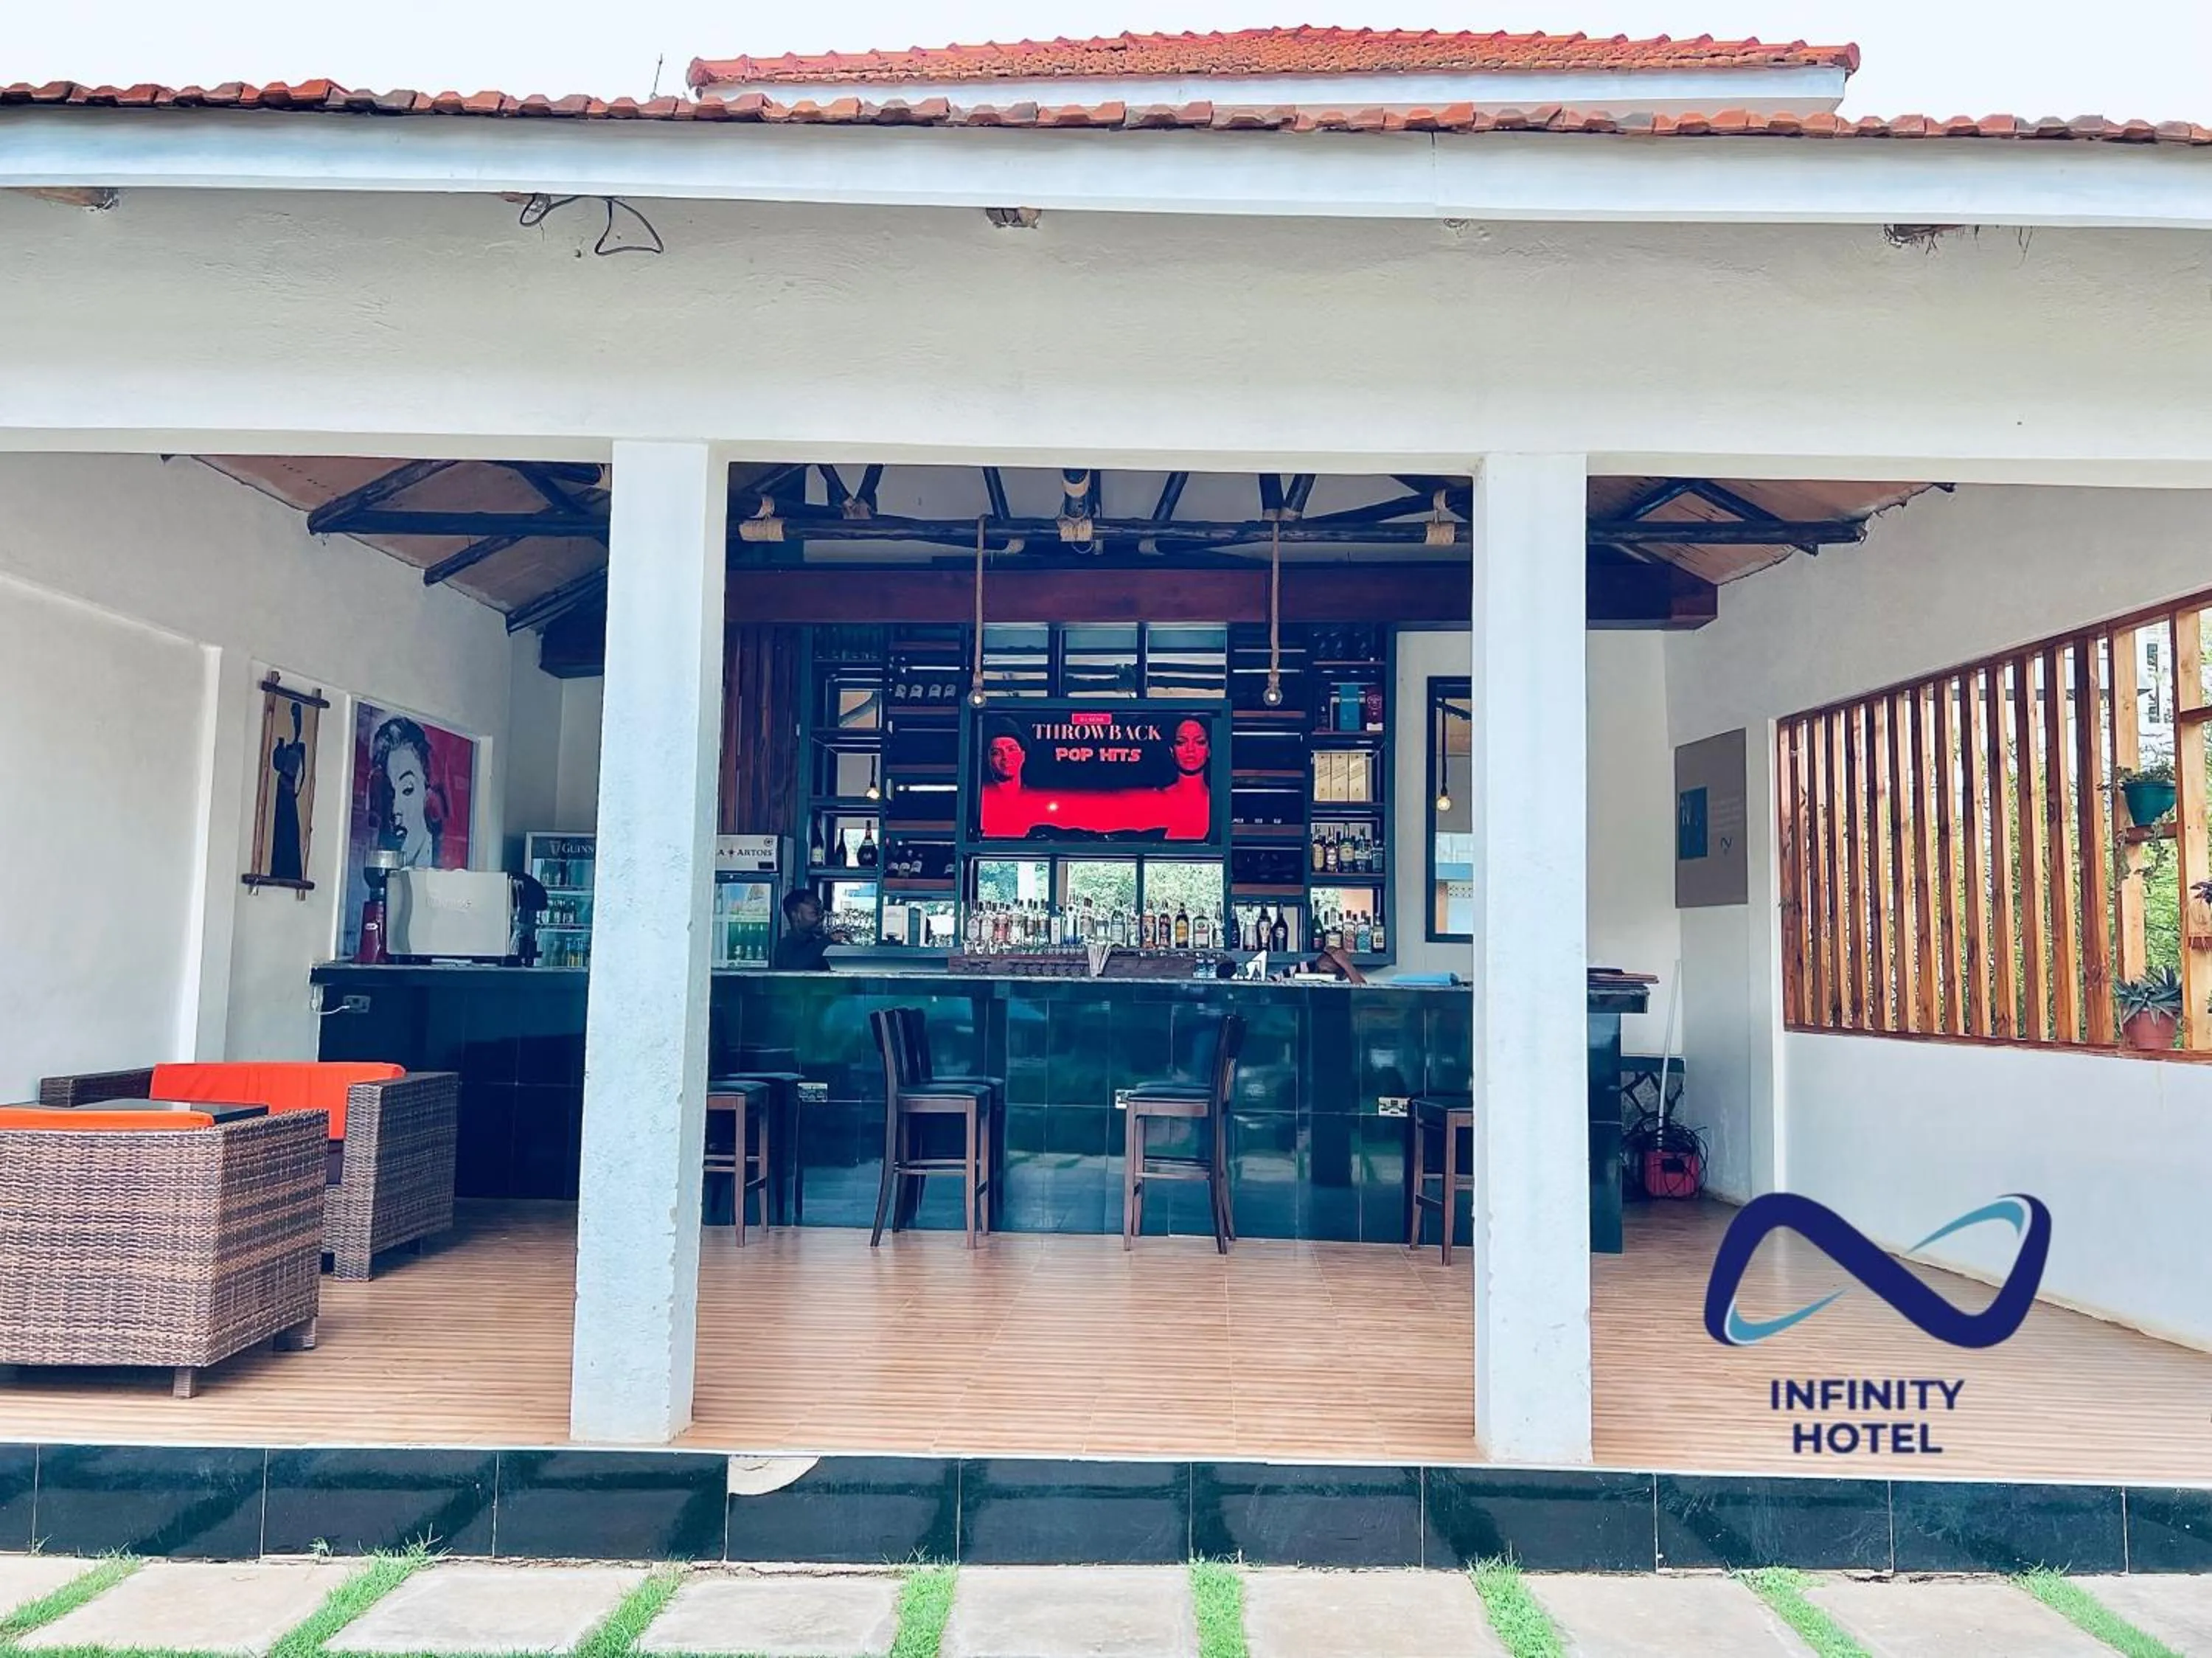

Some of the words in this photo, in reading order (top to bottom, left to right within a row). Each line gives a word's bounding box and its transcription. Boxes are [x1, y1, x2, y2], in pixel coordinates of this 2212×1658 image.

[1032, 724, 1162, 740] THROWBACK
[1055, 746, 1093, 762] POP
[1099, 747, 1142, 763] HITS
[562, 842, 595, 854] GUINN
